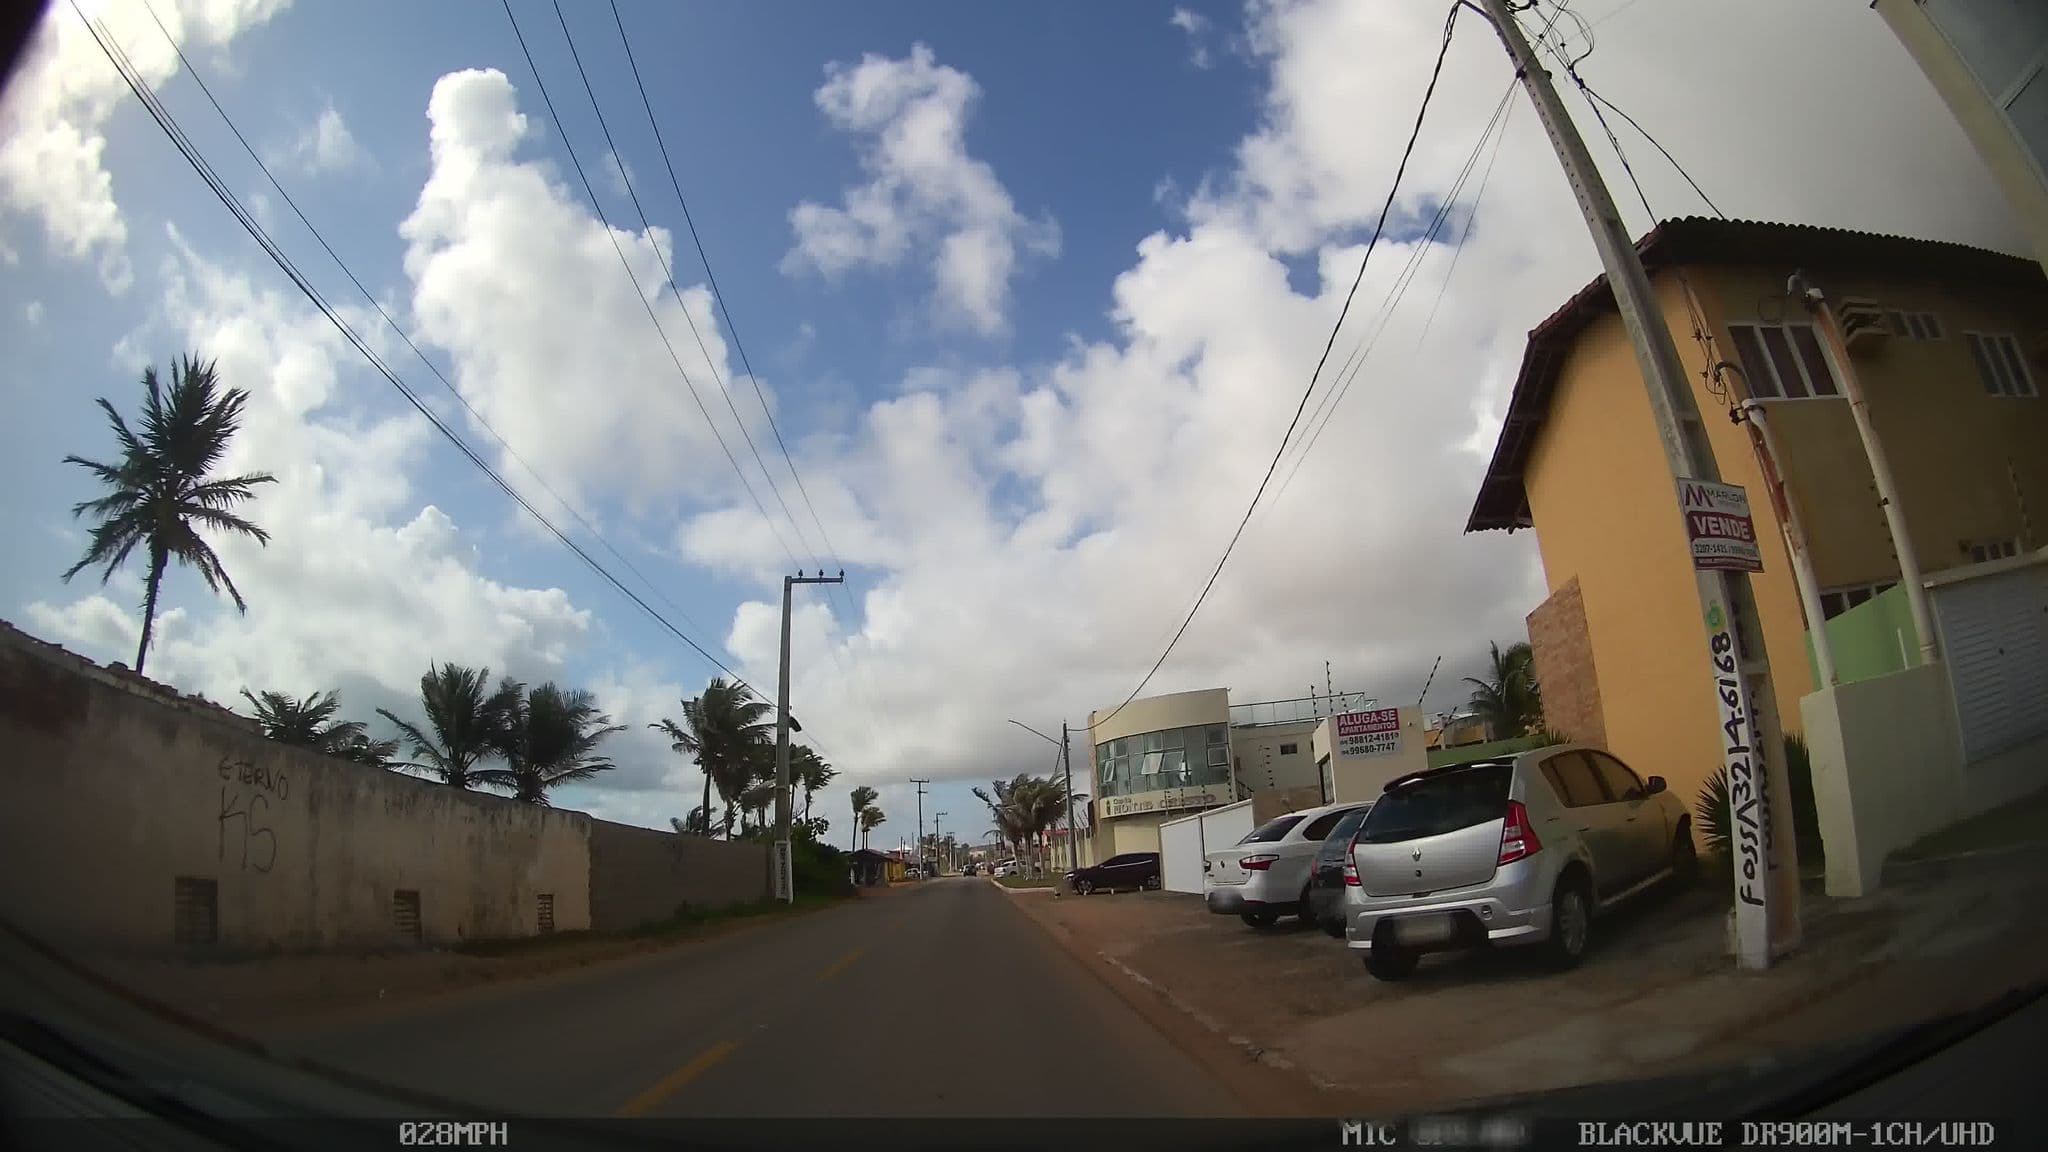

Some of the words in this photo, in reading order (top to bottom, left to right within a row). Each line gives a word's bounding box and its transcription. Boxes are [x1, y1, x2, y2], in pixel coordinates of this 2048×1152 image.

[1692, 515, 1750, 540] VENDE
[1340, 710, 1397, 726] ALUGA-SE
[1341, 722, 1396, 735] APARTAMENTOS
